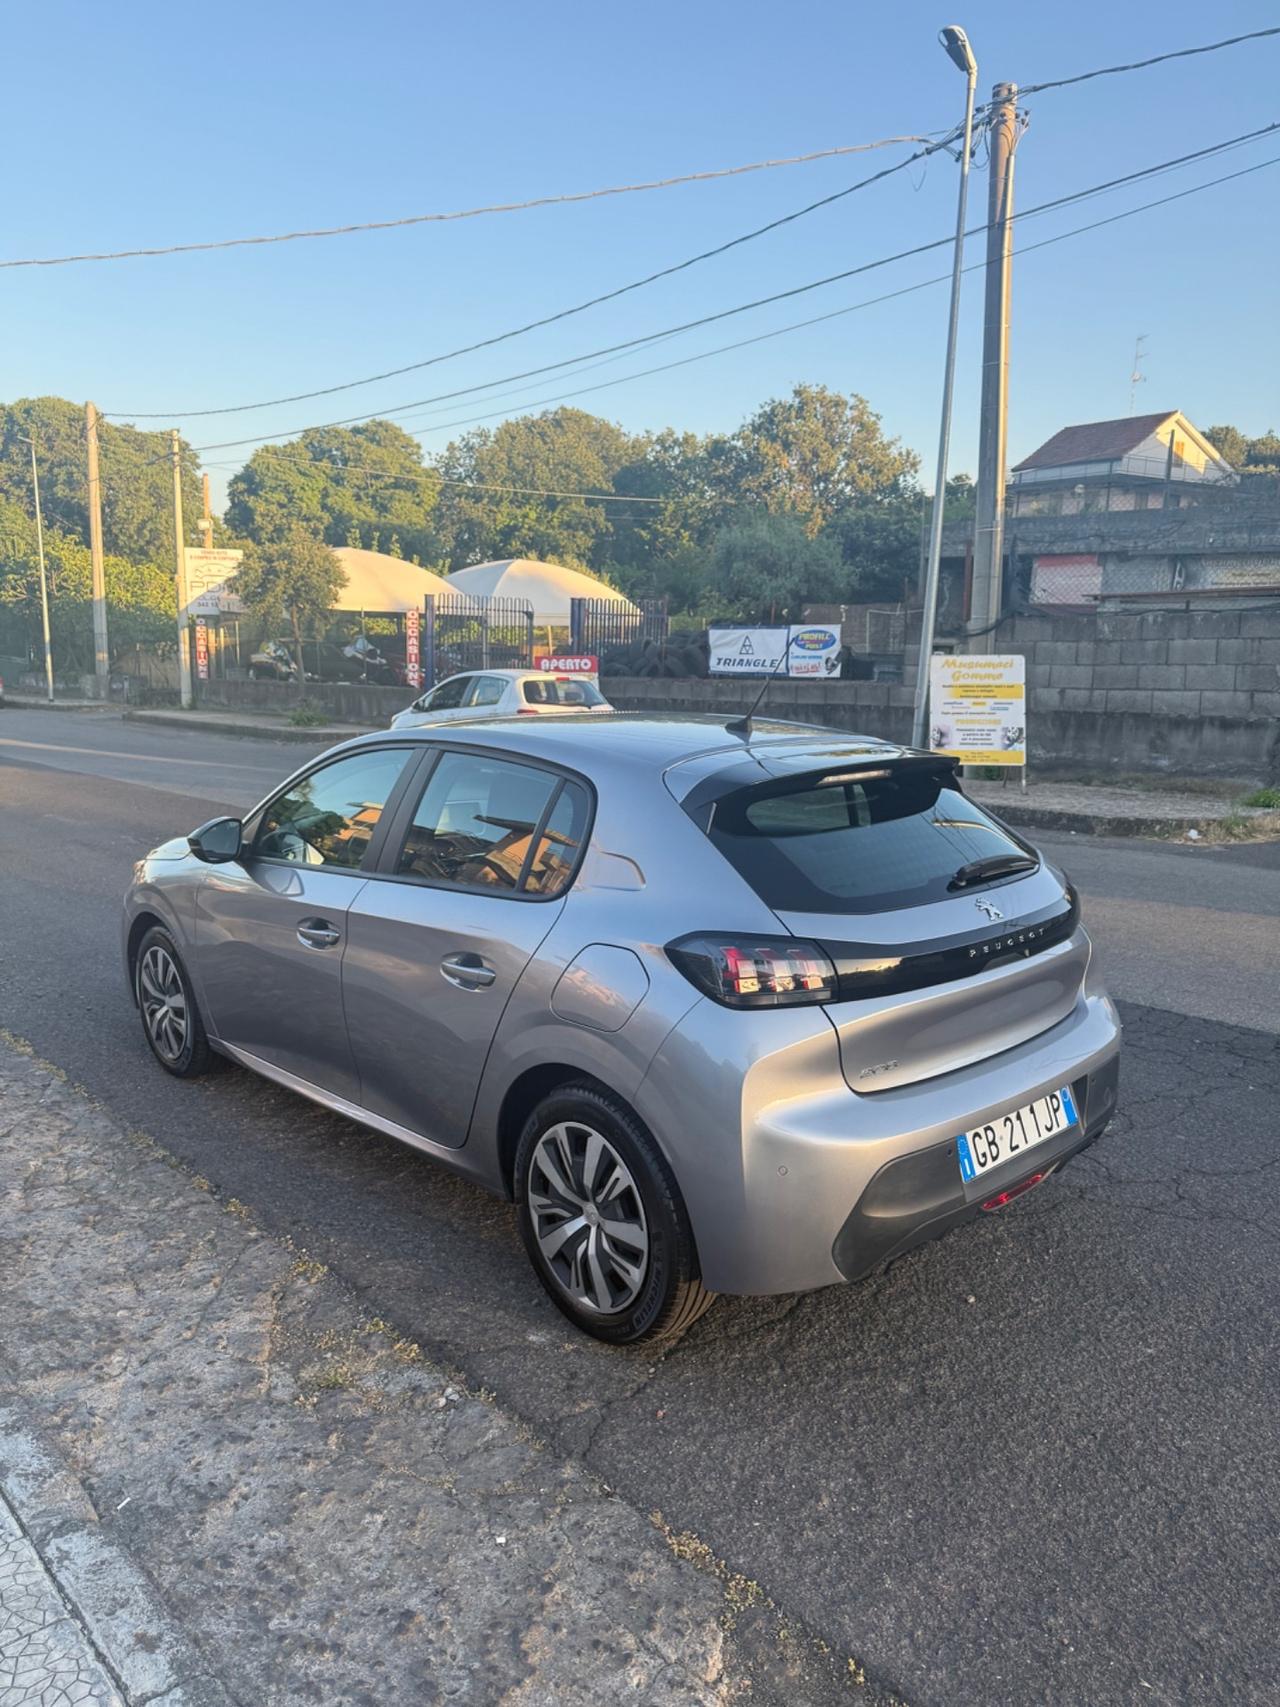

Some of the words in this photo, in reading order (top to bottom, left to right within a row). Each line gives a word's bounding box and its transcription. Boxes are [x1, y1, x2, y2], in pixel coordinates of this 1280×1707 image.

[540, 658, 592, 670] APERTO
[715, 657, 778, 668] TRIANGLE
[969, 927, 1045, 958] PEUGEOT
